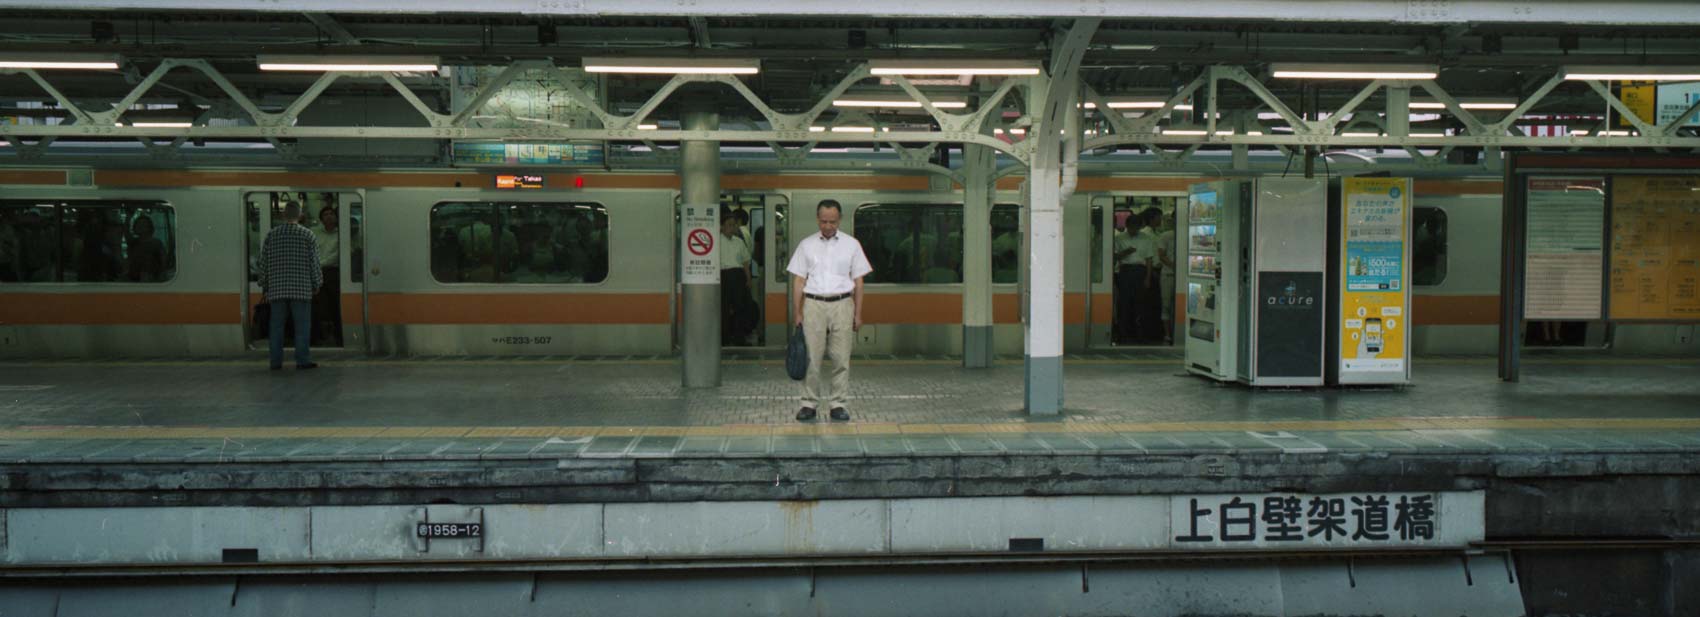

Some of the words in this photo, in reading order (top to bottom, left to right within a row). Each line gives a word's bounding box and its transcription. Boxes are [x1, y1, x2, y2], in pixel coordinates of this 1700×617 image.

[1684, 93, 1689, 103] 1
[1267, 296, 1314, 305] acure
[1175, 495, 1434, 542] 上白壁架道橋
